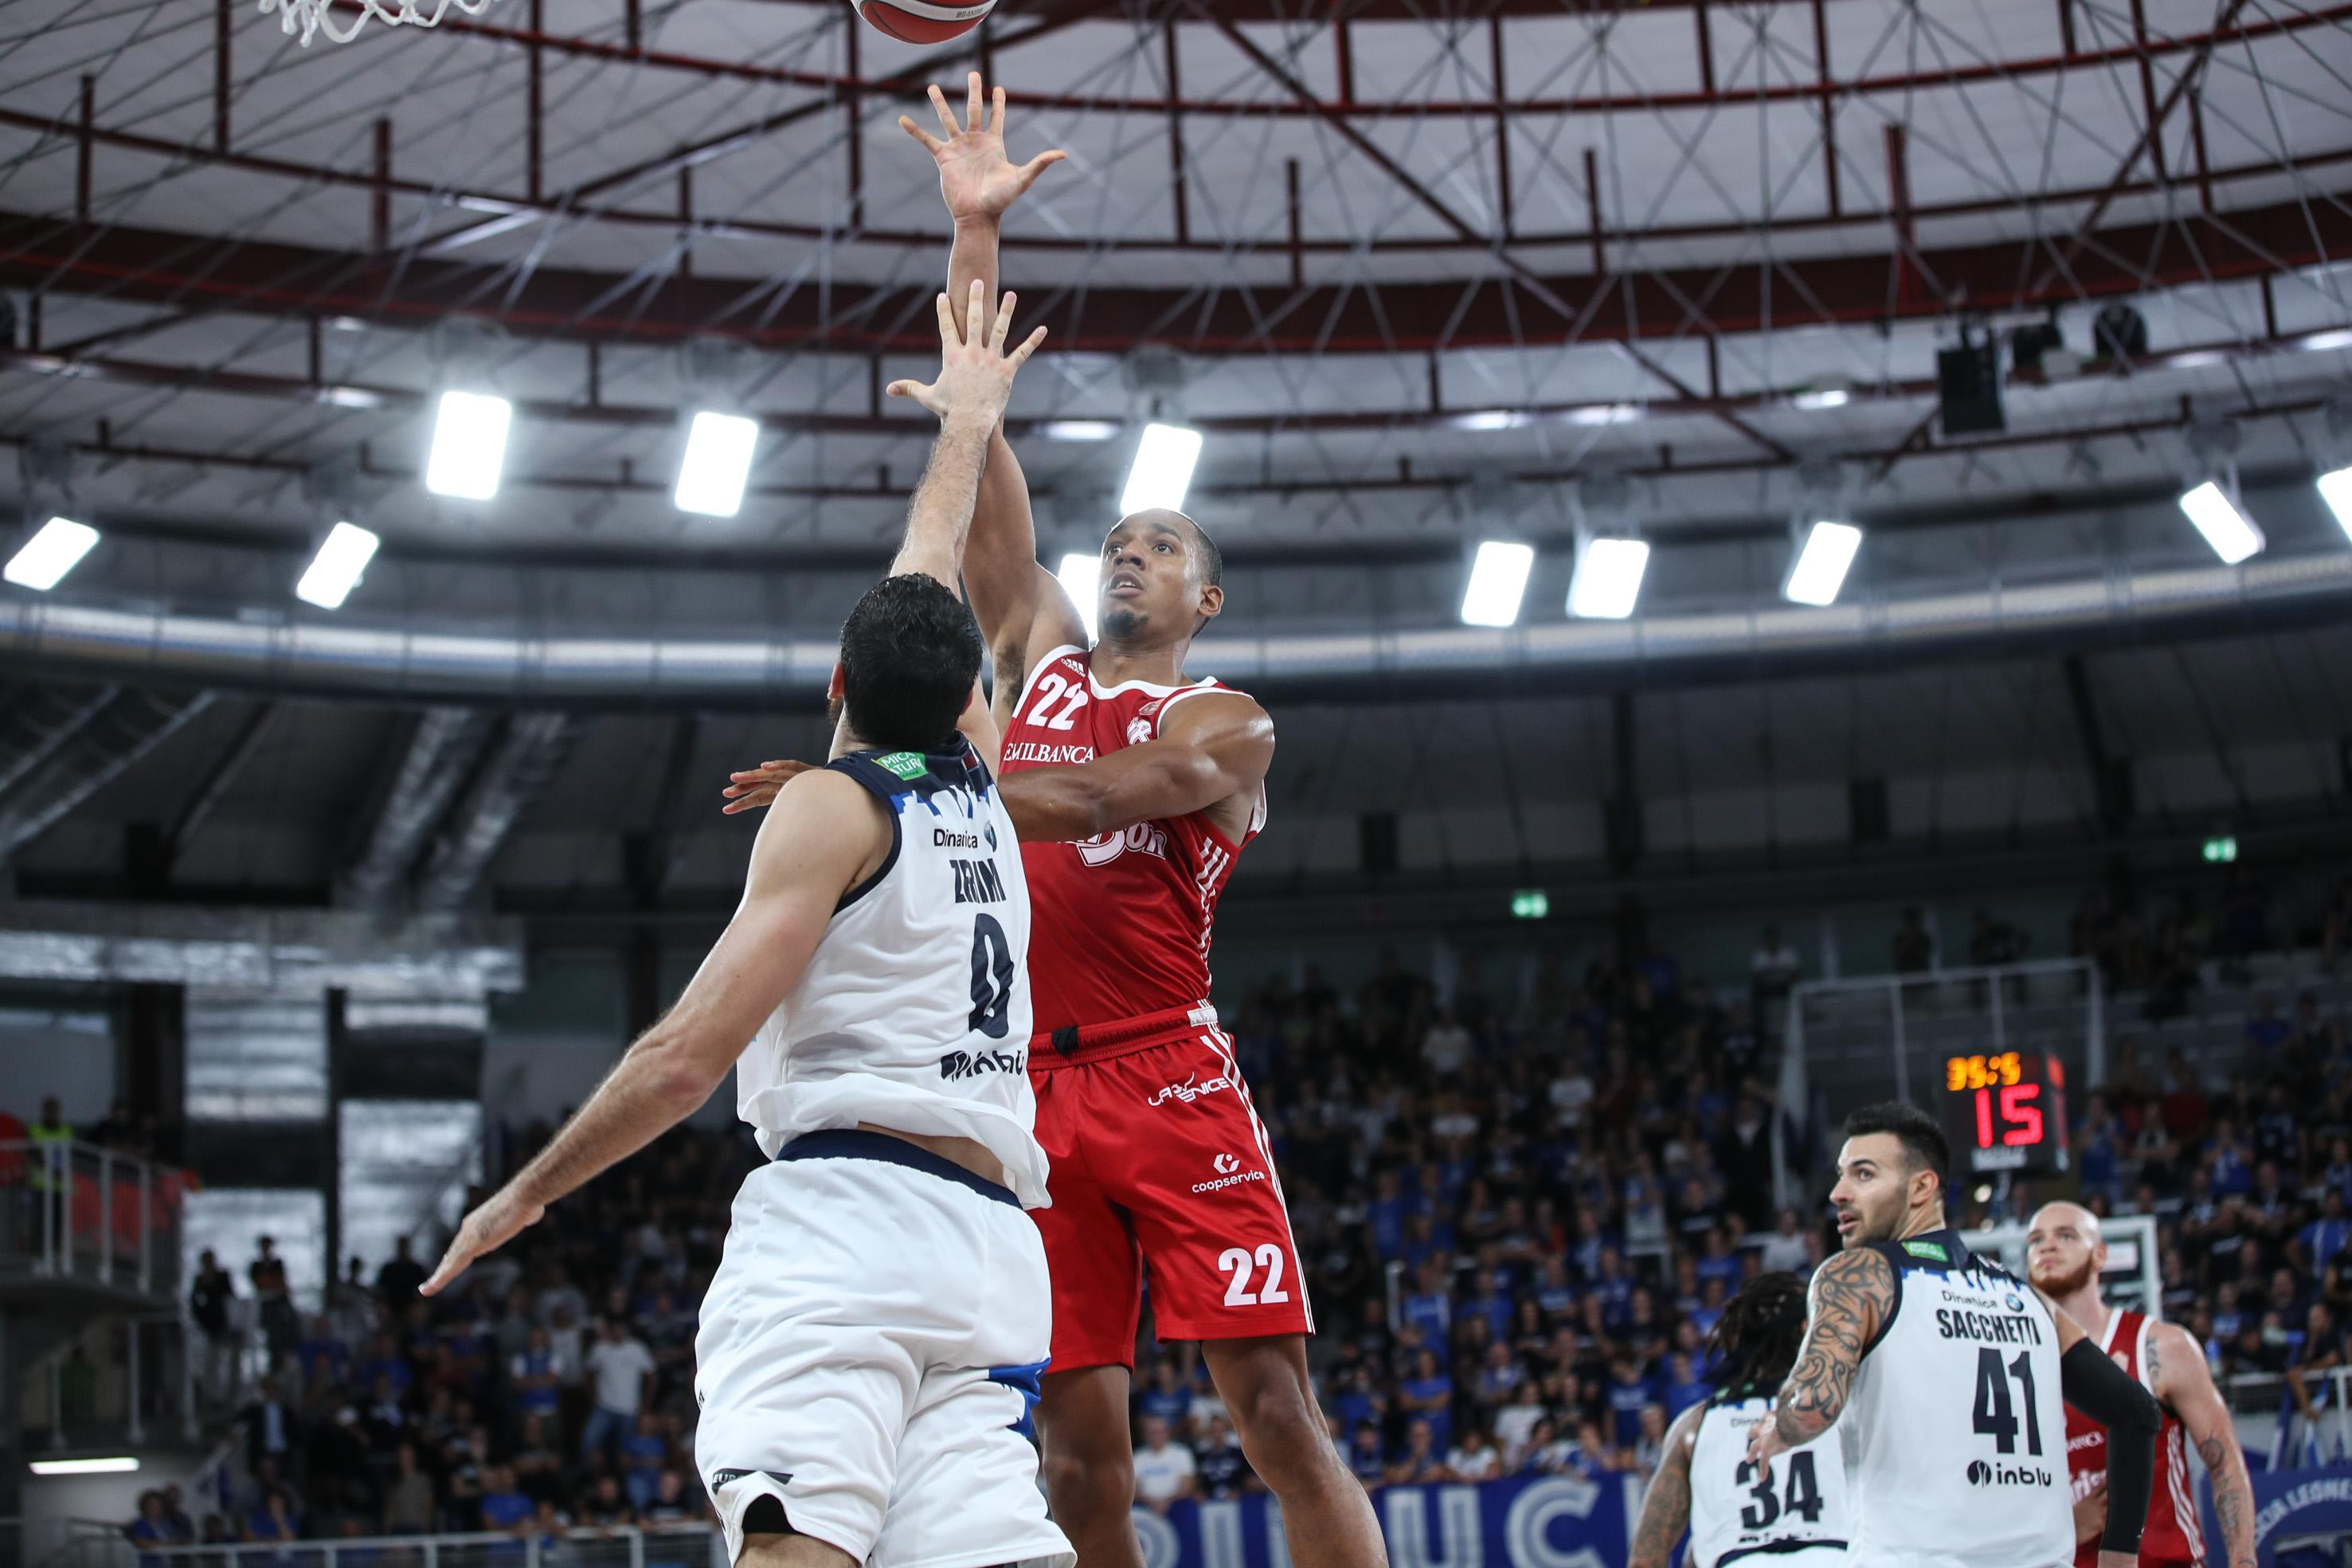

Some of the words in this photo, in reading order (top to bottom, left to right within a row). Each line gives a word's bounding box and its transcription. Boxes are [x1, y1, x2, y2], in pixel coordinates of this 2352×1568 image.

[1025, 672, 1089, 731] 22
[1003, 741, 1094, 764] EMILBANCA
[969, 913, 1015, 1039] 0
[1975, 1083, 2044, 1149] 15
[1192, 1170, 1265, 1194] coopservice
[1218, 1244, 1289, 1307] 22
[1936, 1308, 2041, 1346] SACCHETTI
[1972, 1347, 2043, 1457] 41
[1736, 1450, 1824, 1530] 34
[1996, 1462, 2052, 1487] inblu
